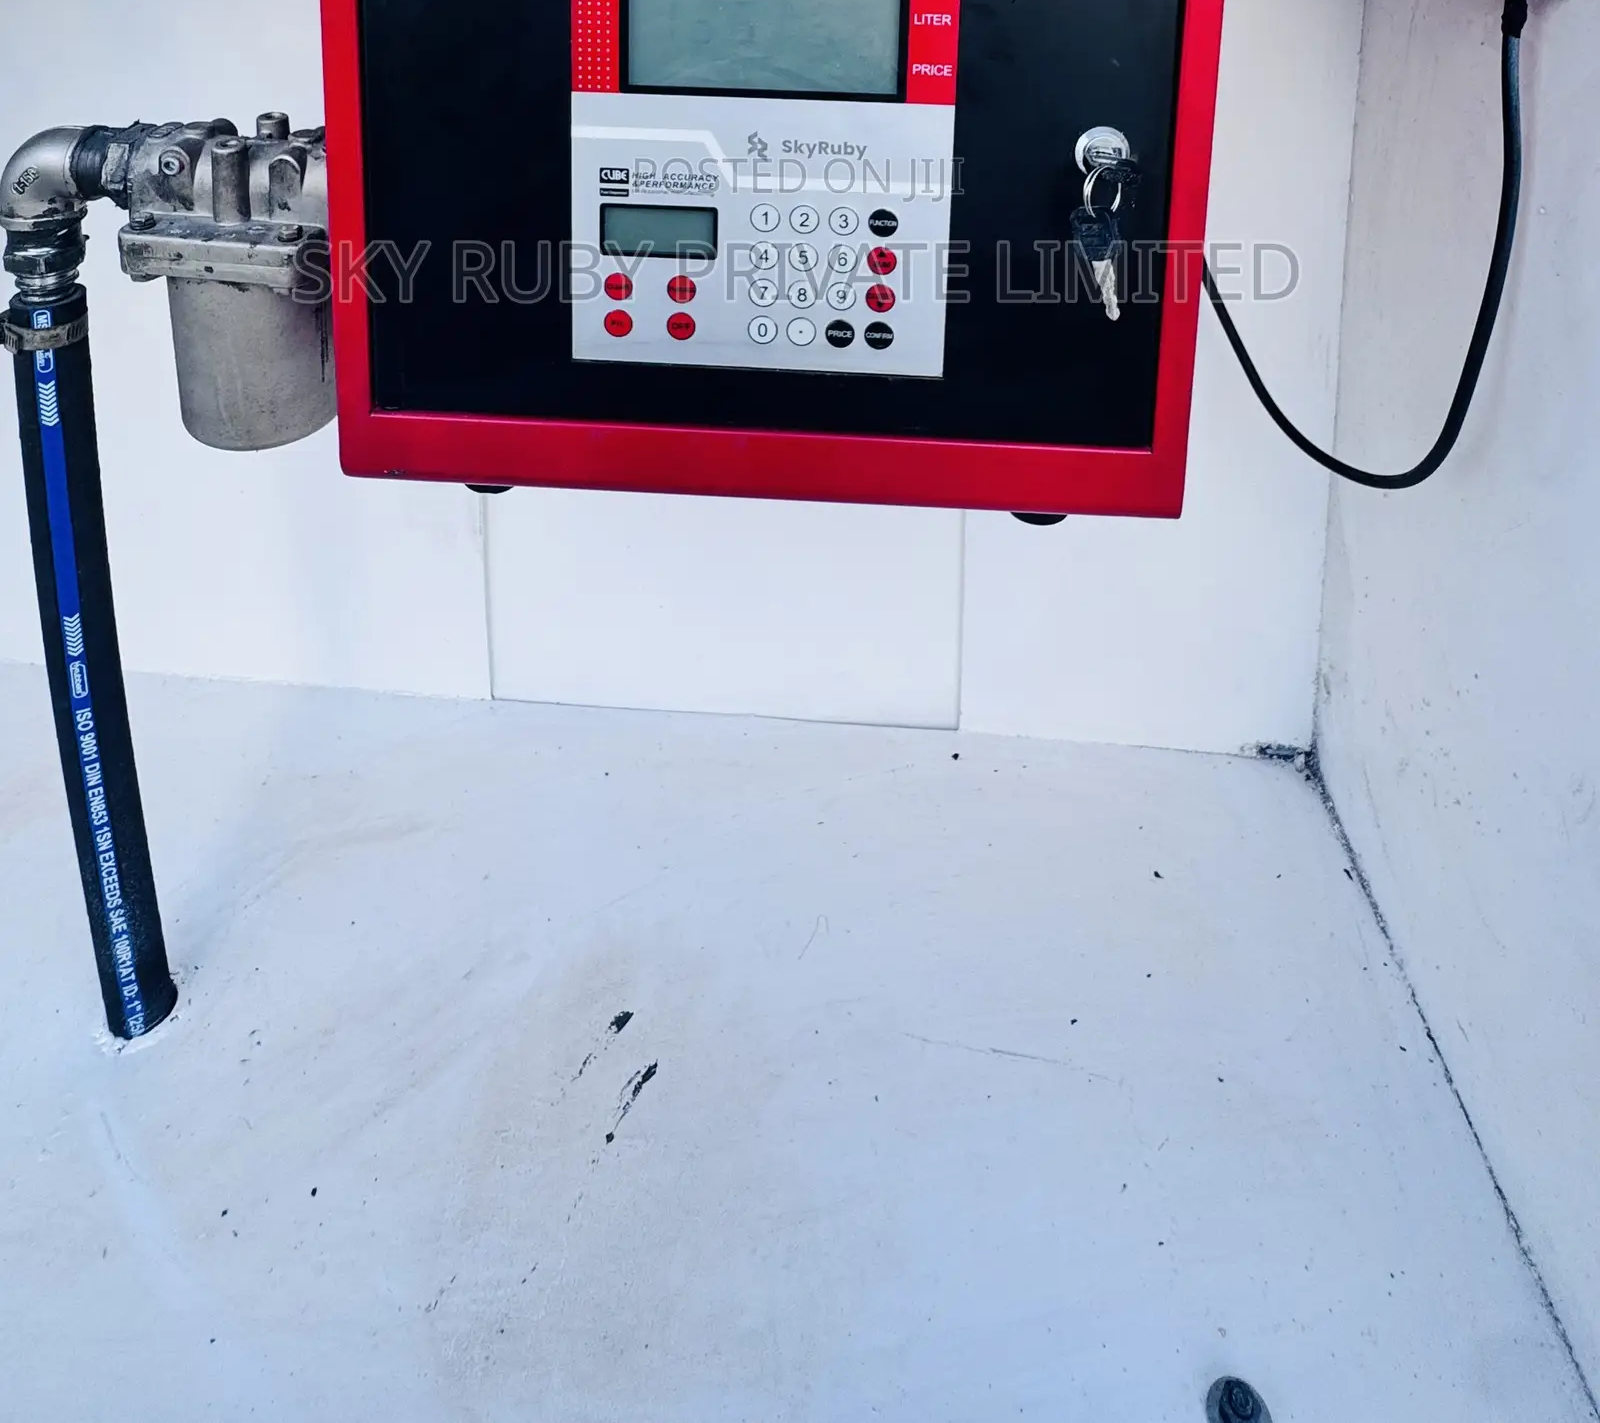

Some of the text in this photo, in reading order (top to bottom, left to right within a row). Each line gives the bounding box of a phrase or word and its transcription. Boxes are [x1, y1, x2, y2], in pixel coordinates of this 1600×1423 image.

[913, 13, 952, 26] LITER
[912, 63, 953, 77] PRICE
[781, 139, 868, 161] SkyRuby
[601, 169, 628, 181] CUBE
[632, 171, 720, 182] HIGH ACCURACY
[761, 211, 768, 225] 1
[799, 212, 810, 227] 2
[838, 213, 849, 229] 3
[869, 219, 898, 227] FUNCTION
[759, 249, 769, 263] 4
[798, 250, 808, 265] 5
[838, 252, 848, 267] 6
[760, 286, 769, 300] 7
[797, 287, 807, 302] 8
[836, 289, 847, 304] 9
[757, 323, 768, 337] 0
[827, 329, 853, 338] PRICE
[865, 331, 893, 340] CONFIRM
[75, 707, 94, 731] ISO
[79, 732, 99, 761] 9001
[84, 762, 101, 786] DIN
[88, 786, 109, 826] EN853
[95, 825, 113, 851] 1SN
[99, 852, 123, 909] EXCEEDS
[109, 908, 128, 935] SAE
[112, 934, 136, 983] 100R1AT
[121, 984, 140, 1000] ID:
